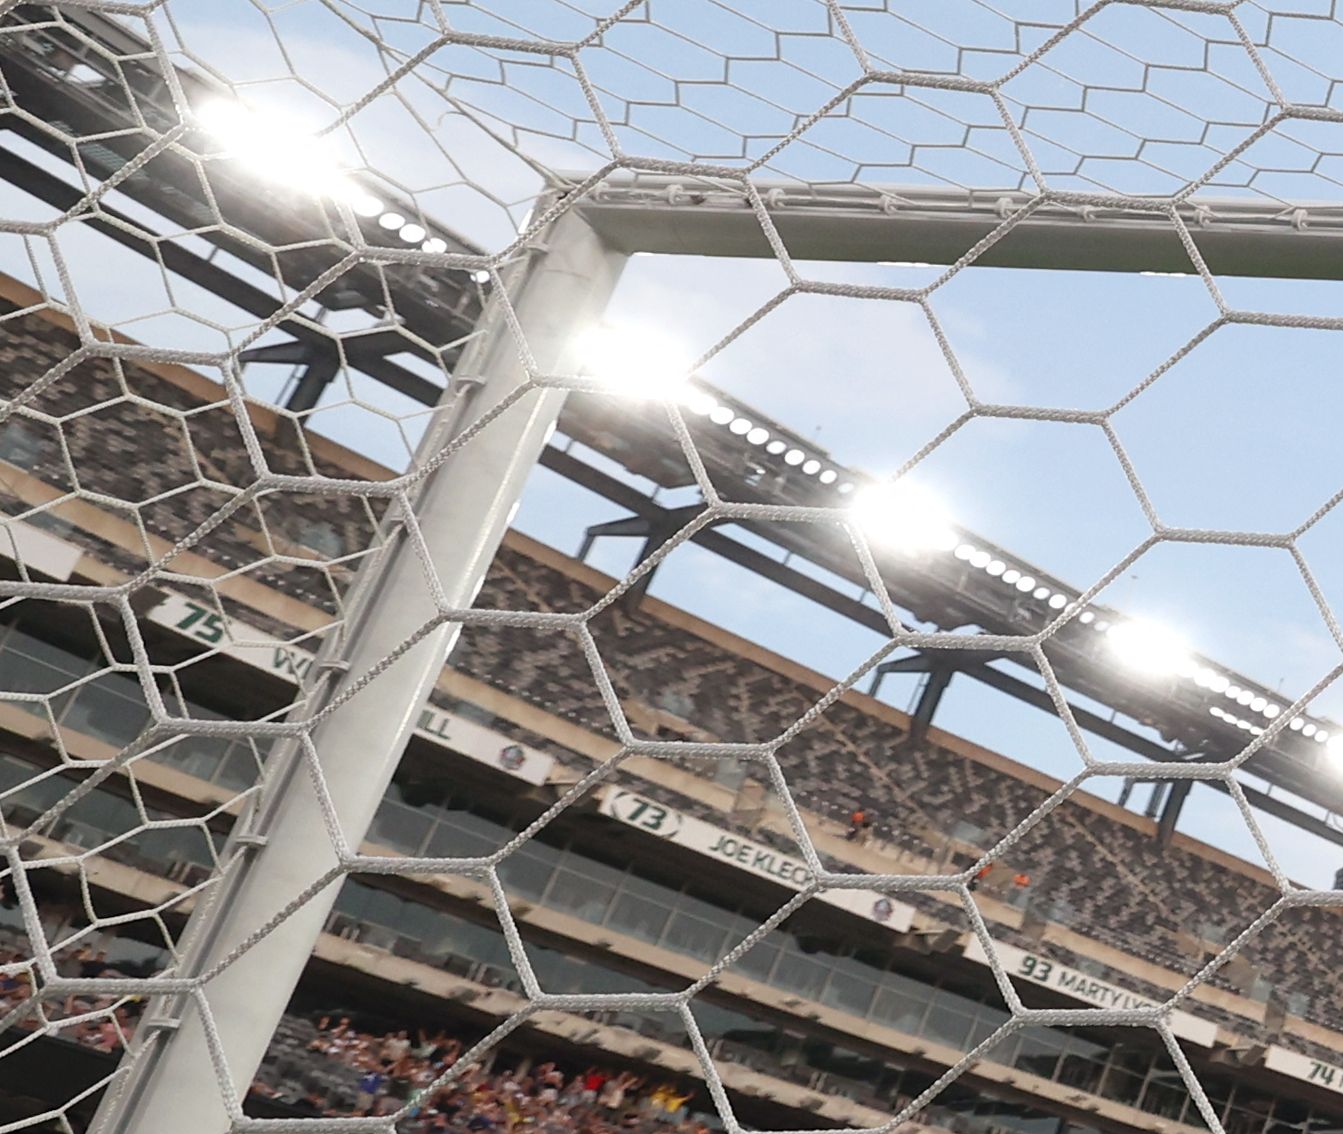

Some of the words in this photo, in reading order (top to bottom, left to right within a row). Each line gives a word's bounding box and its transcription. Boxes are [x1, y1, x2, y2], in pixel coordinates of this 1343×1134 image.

[176, 603, 224, 643] 75
[627, 799, 668, 830] 73
[710, 835, 751, 864] JOE
[1019, 956, 1052, 982] 93
[1058, 971, 1123, 1008] MARTY
[1306, 1061, 1336, 1086] 74
